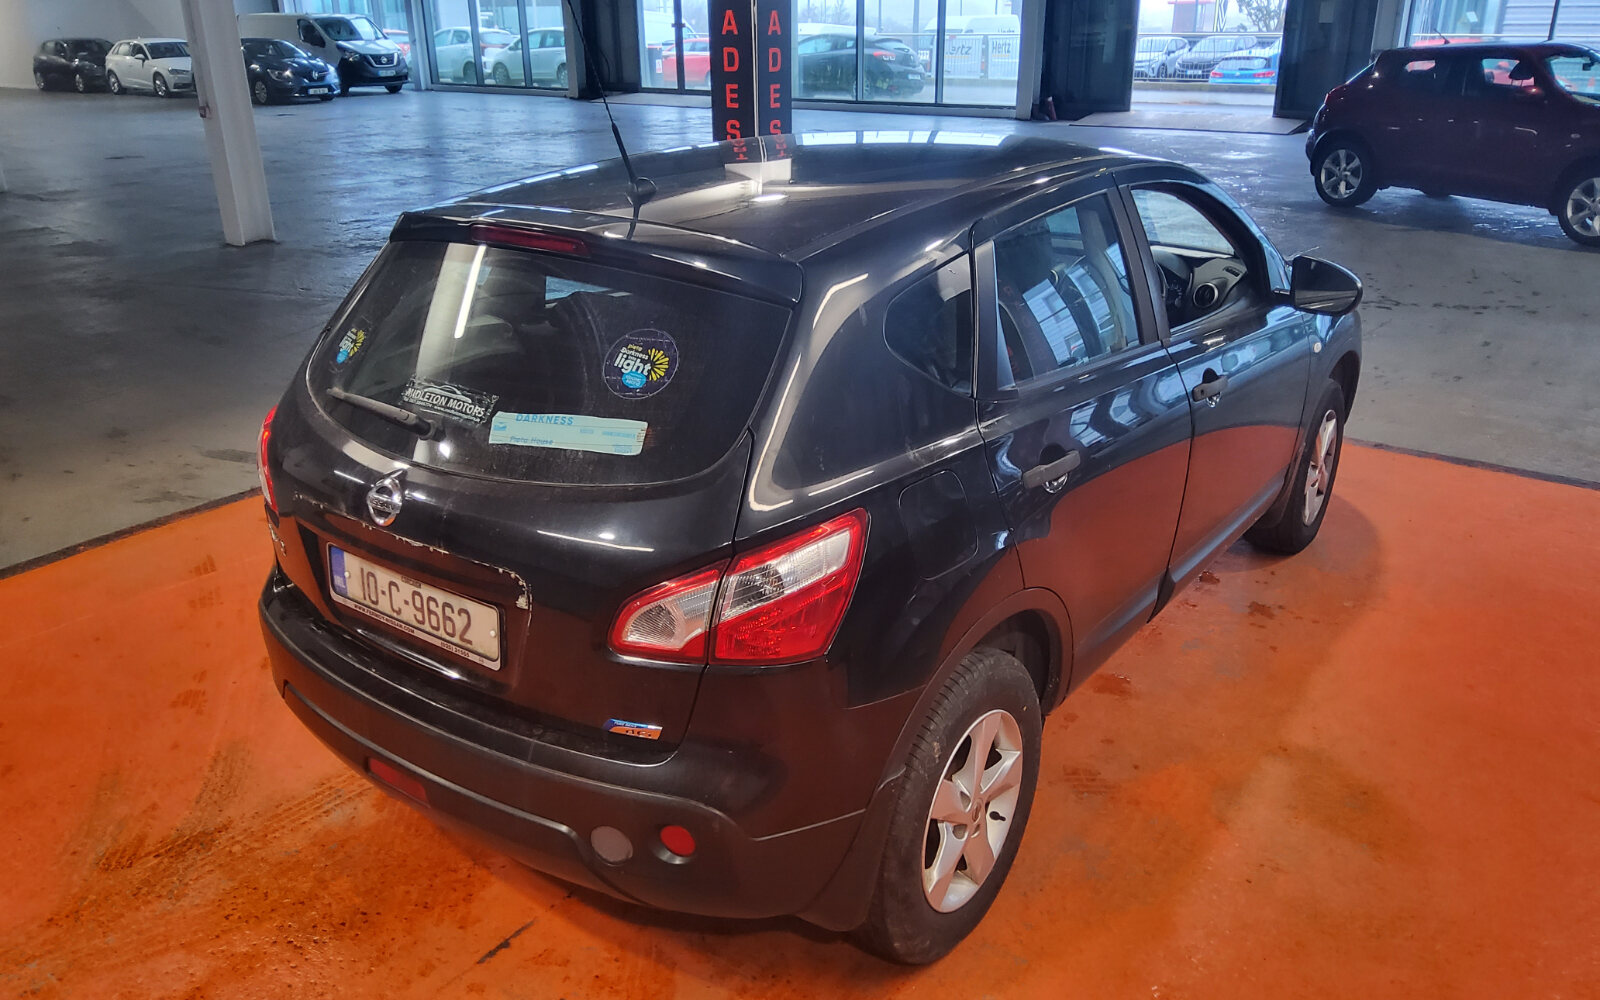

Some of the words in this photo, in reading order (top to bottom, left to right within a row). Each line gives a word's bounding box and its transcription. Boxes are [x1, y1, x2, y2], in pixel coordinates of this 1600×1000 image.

[992, 39, 1011, 54] Hertz
[620, 346, 649, 360] Darkness
[613, 352, 652, 376] light
[447, 398, 486, 418] MOTORS
[515, 413, 574, 426] DARKNESS
[360, 567, 473, 646] 10-C-9662
